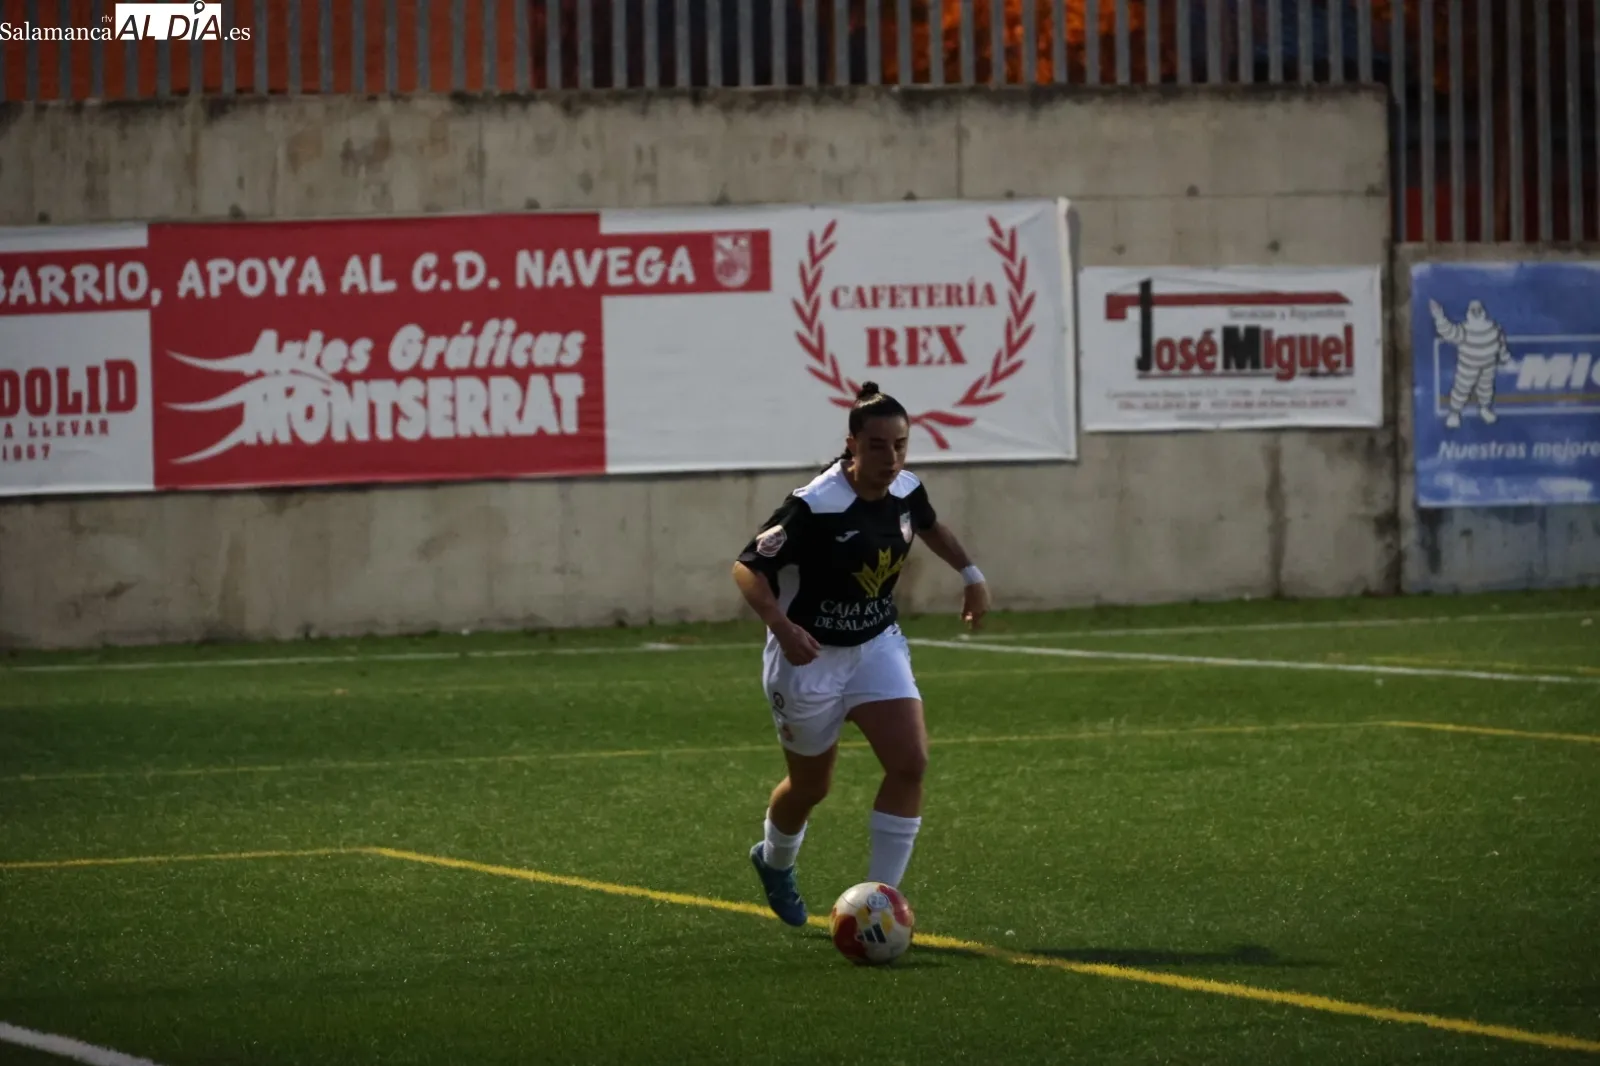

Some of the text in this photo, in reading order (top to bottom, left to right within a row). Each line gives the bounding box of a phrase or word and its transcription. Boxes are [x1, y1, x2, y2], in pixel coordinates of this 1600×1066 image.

[0, 246, 696, 307] ARRIO, APOYA AL C.D. NAVEGA
[830, 276, 997, 310] CAFETERÍA
[1136, 278, 1218, 373] José
[244, 317, 586, 375] Artes Gráficas
[864, 324, 968, 369] REX
[28, 418, 109, 438] LLEVAR
[242, 372, 585, 445] MONTSERRAT
[1437, 440, 1527, 460] Nuestras
[814, 615, 833, 629] DE
[820, 600, 861, 618] CAJA
